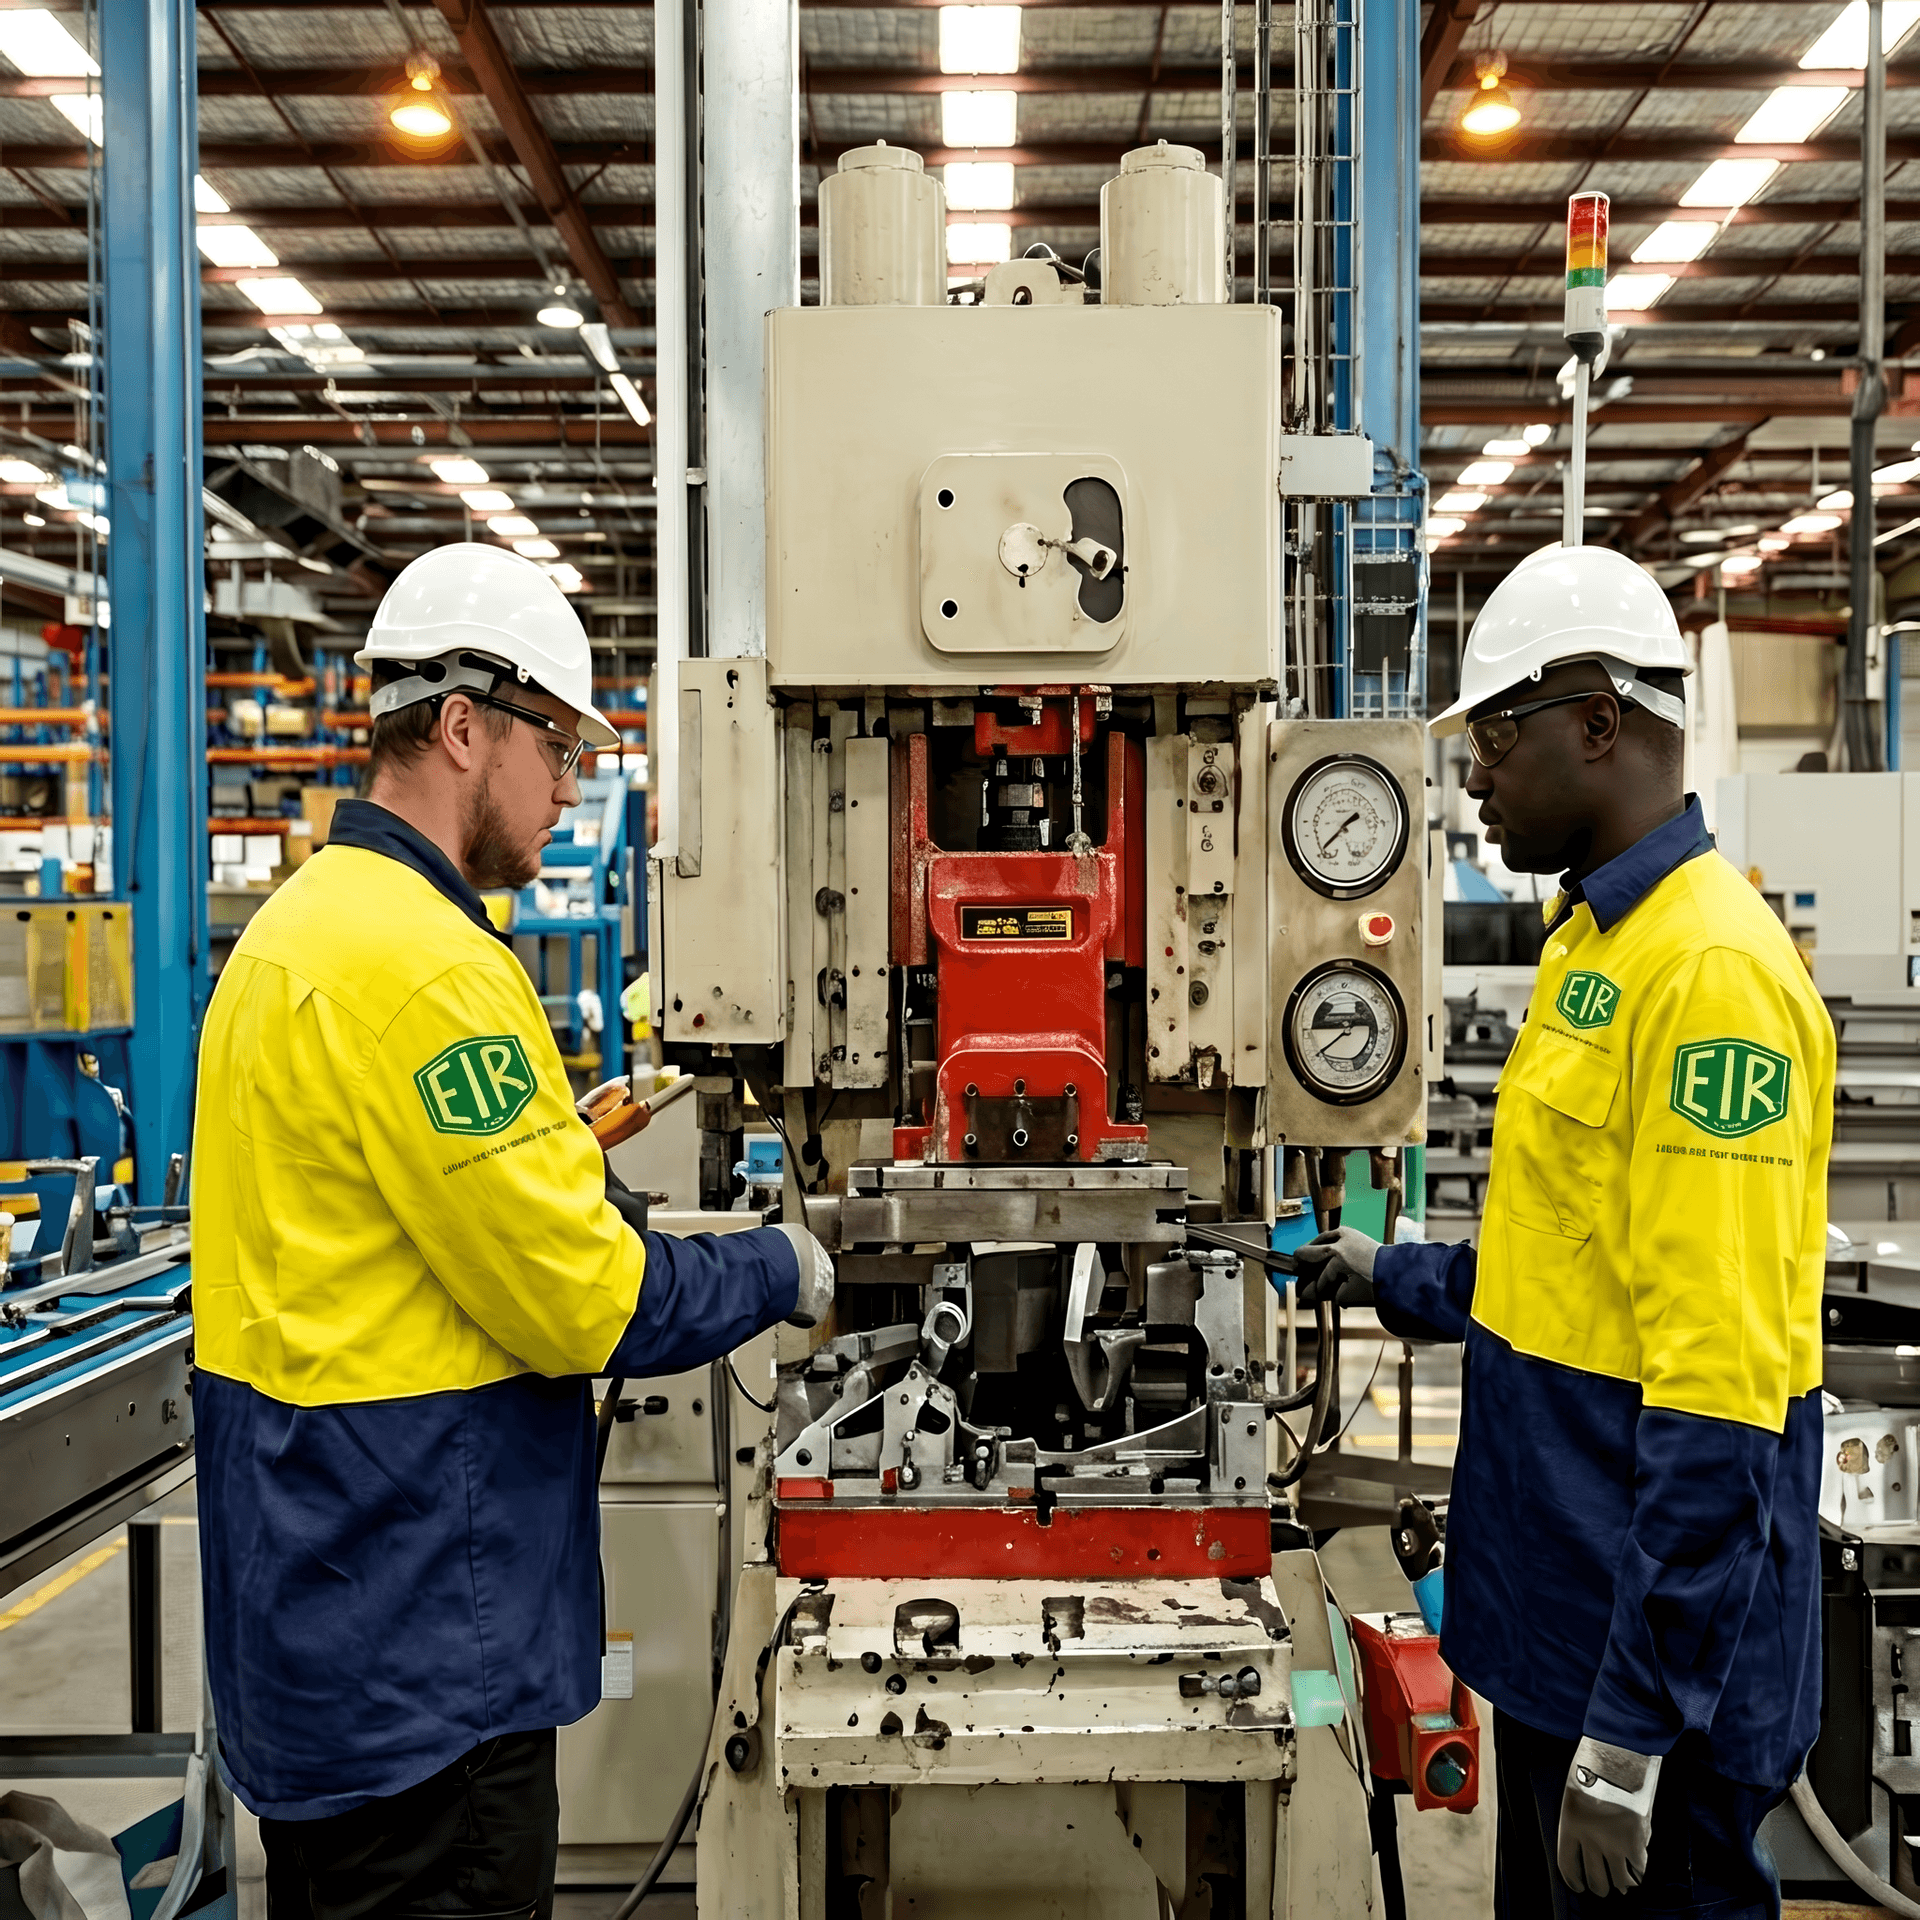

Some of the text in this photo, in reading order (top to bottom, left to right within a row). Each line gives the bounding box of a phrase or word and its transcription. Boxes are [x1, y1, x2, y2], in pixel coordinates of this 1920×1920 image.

[1562, 976, 1615, 1021] EIR
[427, 1044, 528, 1125] EIR
[1682, 1048, 1777, 1121] EIR
